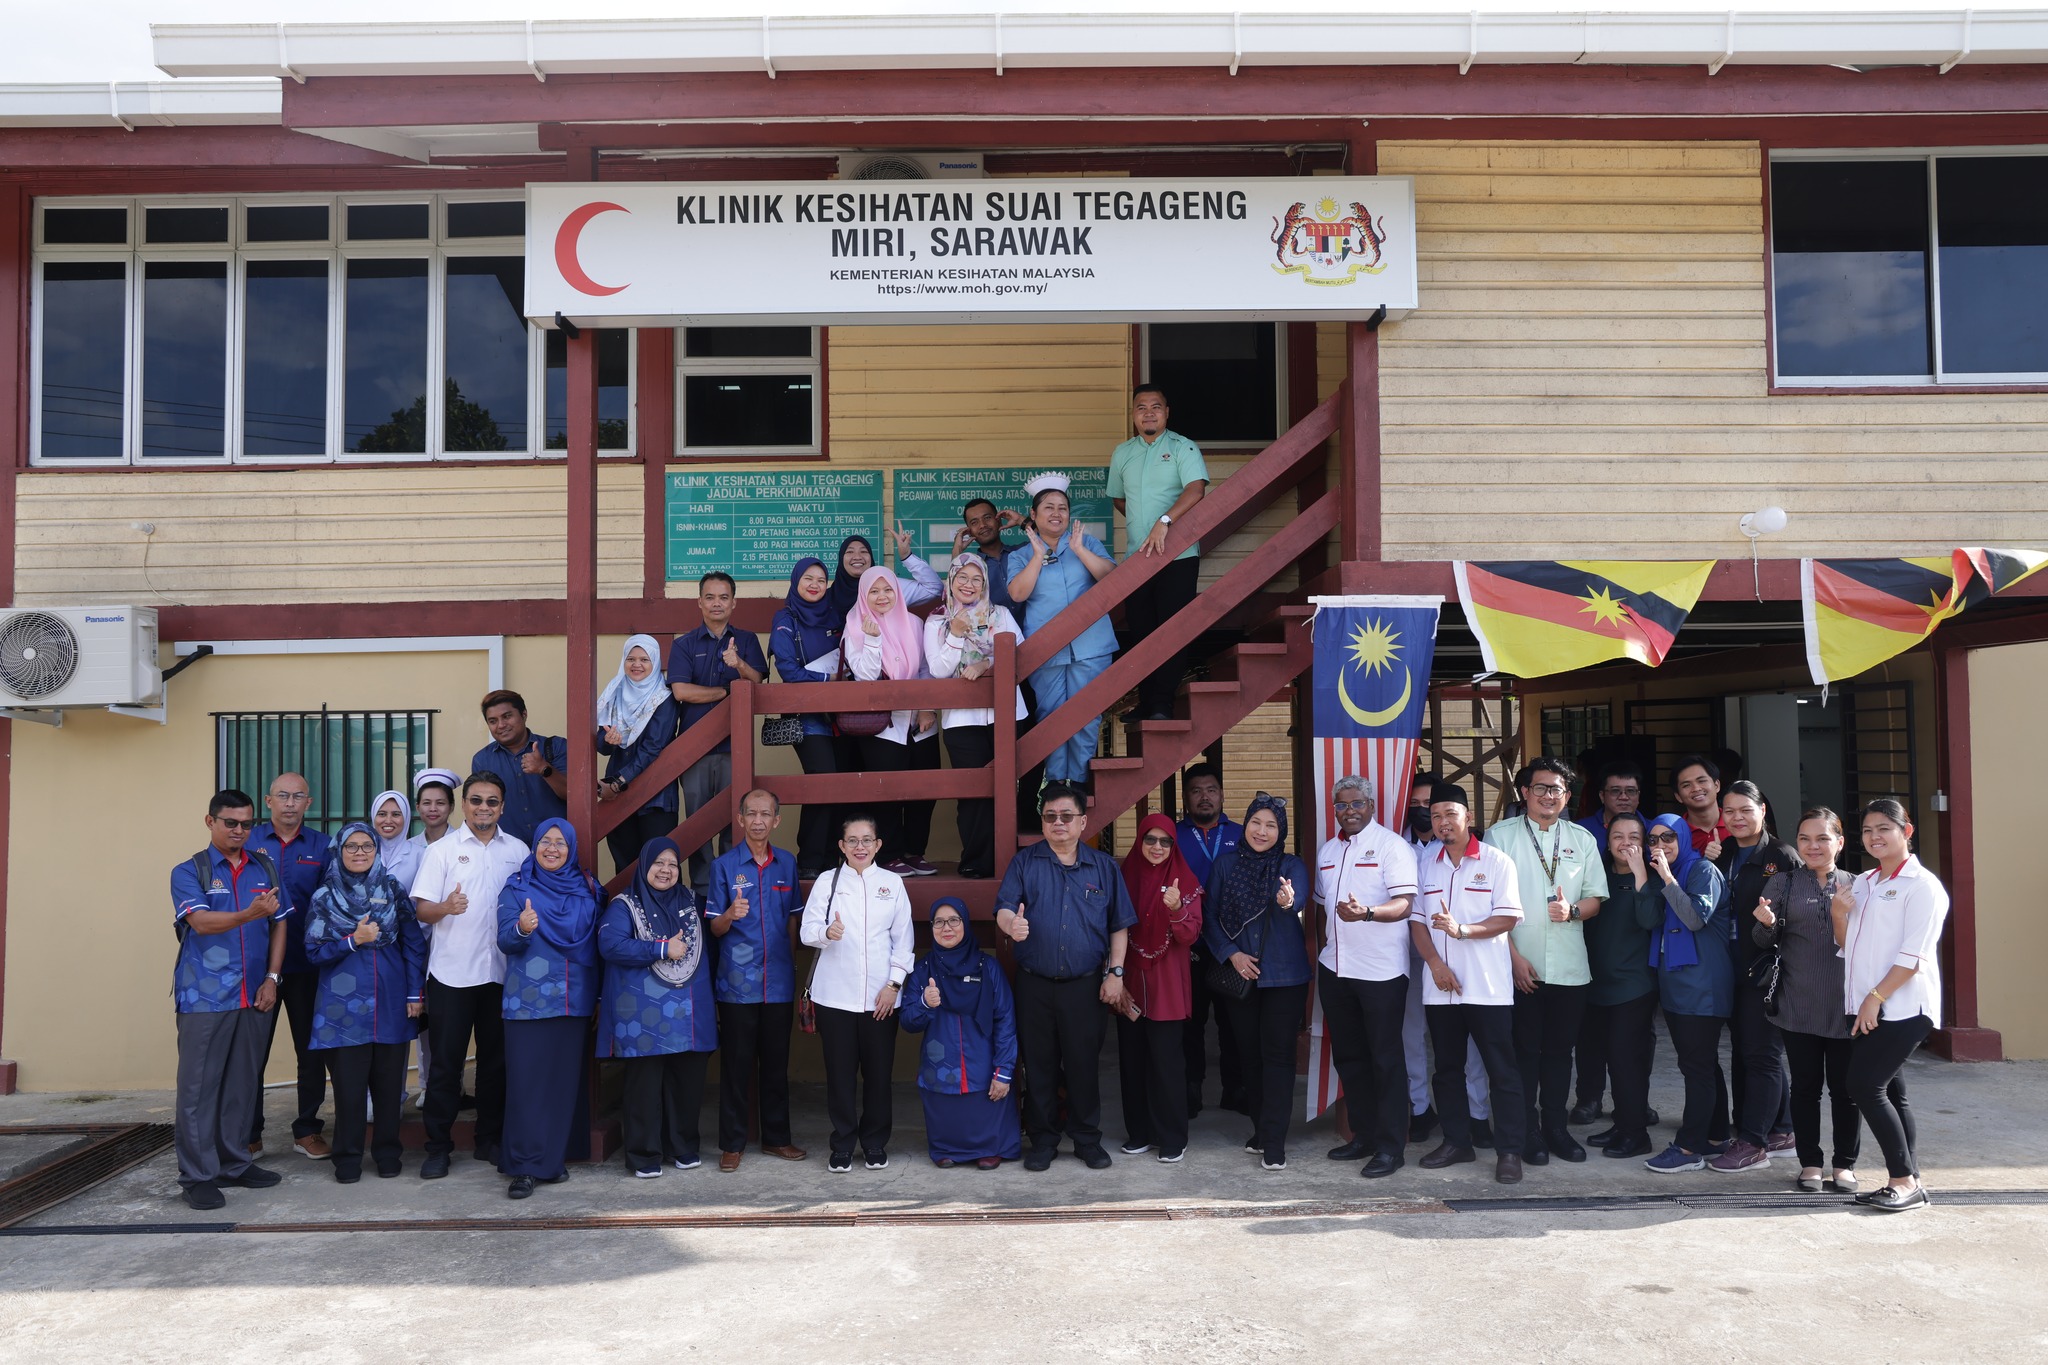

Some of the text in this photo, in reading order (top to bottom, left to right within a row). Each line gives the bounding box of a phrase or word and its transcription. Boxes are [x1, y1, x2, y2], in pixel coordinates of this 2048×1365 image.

[677, 190, 1247, 225] KLINIK KESIHATAN SUAI TEGAGENG
[832, 226, 1093, 262] MIRI, SARAWAK
[830, 267, 1095, 281] KEMENTERIAN KESIHATAN MALAYSIA
[877, 282, 1048, 297] https://www.moh.gov.my/
[674, 474, 873, 487] KLINIK KESIHATAN SUAI TEGAGENG
[901, 472, 937, 483] KLINIK
[942, 471, 1005, 482] KESIHATAN
[707, 487, 840, 499] JADUAL PERKHIDMATAN
[899, 490, 934, 501] PEGAWAI
[937, 490, 958, 500] YANG
[960, 489, 1003, 500] BERTUGAS
[1005, 489, 1025, 499] ATAS
[1075, 488, 1093, 499] HARI
[689, 504, 714, 513] HARI
[787, 503, 825, 512] WAKTU
[749, 515, 864, 525] 8.00 PAGI HINGGA 1.00 PETANG
[676, 523, 727, 531] ISNIN-KHAMIS
[742, 527, 870, 537] 2.00 PETANG HINGGA 5.00 PETANG
[753, 540, 839, 549] 8.00 PAGI HINGGA 11.45
[686, 547, 716, 556] JUMAAT
[742, 553, 756, 561] 2.15
[758, 553, 788, 561] PETANG
[823, 552, 838, 560] 5.00
[85, 615, 124, 623] Panasonic
